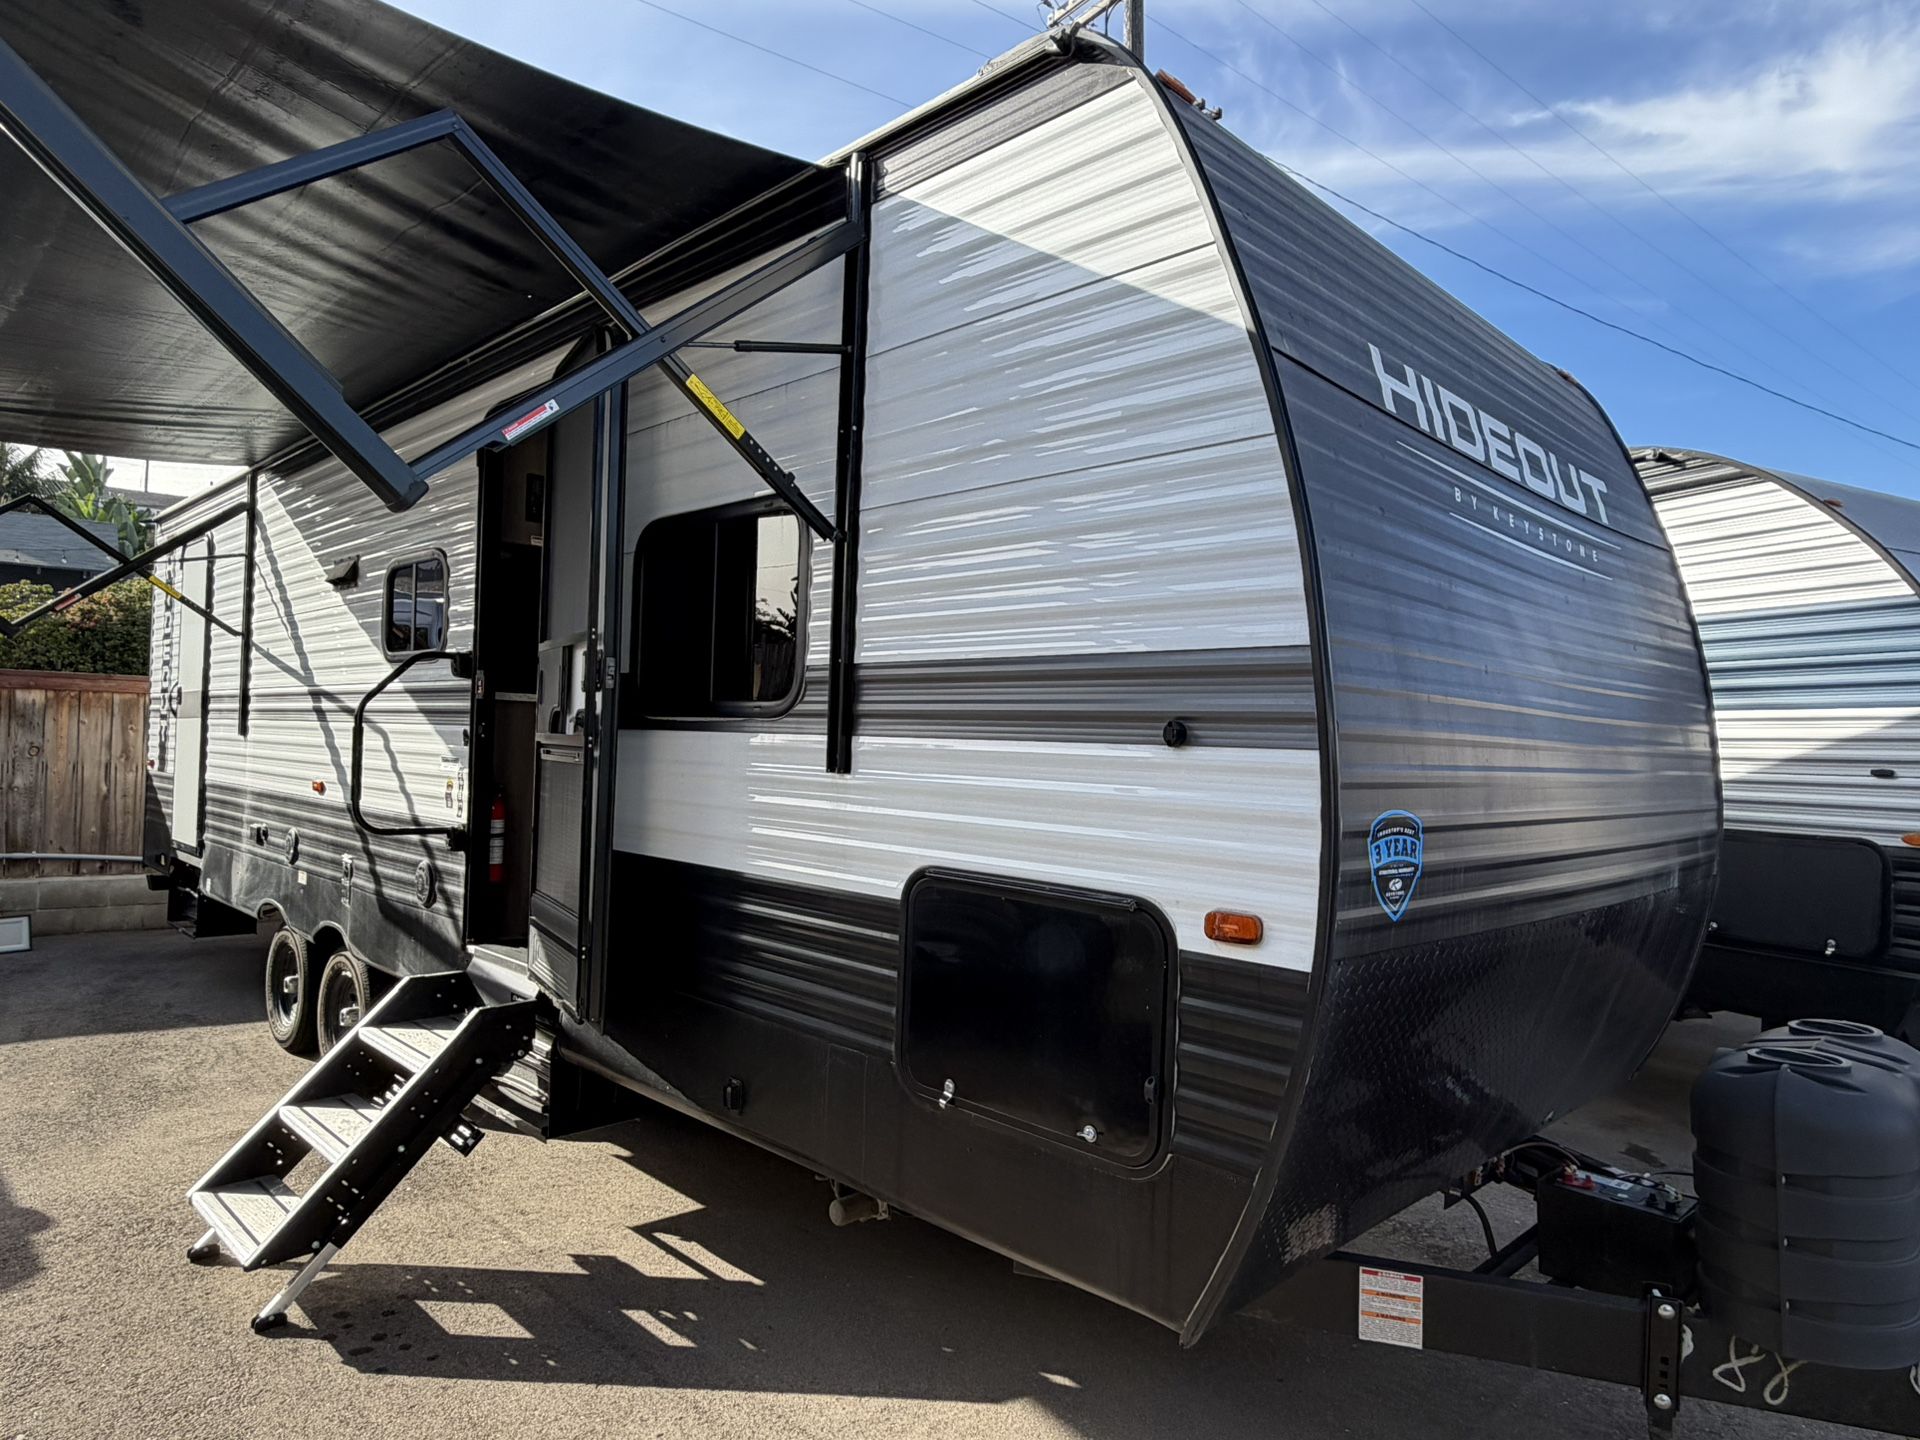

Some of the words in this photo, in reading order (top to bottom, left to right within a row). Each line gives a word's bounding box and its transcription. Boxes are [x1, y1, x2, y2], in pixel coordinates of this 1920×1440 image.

[1367, 342, 1608, 525] HIDEOUT
[1454, 486, 1477, 511] BY
[1493, 505, 1599, 562] KEYSTONE
[1374, 844, 1382, 864] 3
[1385, 838, 1417, 859] YEAR
